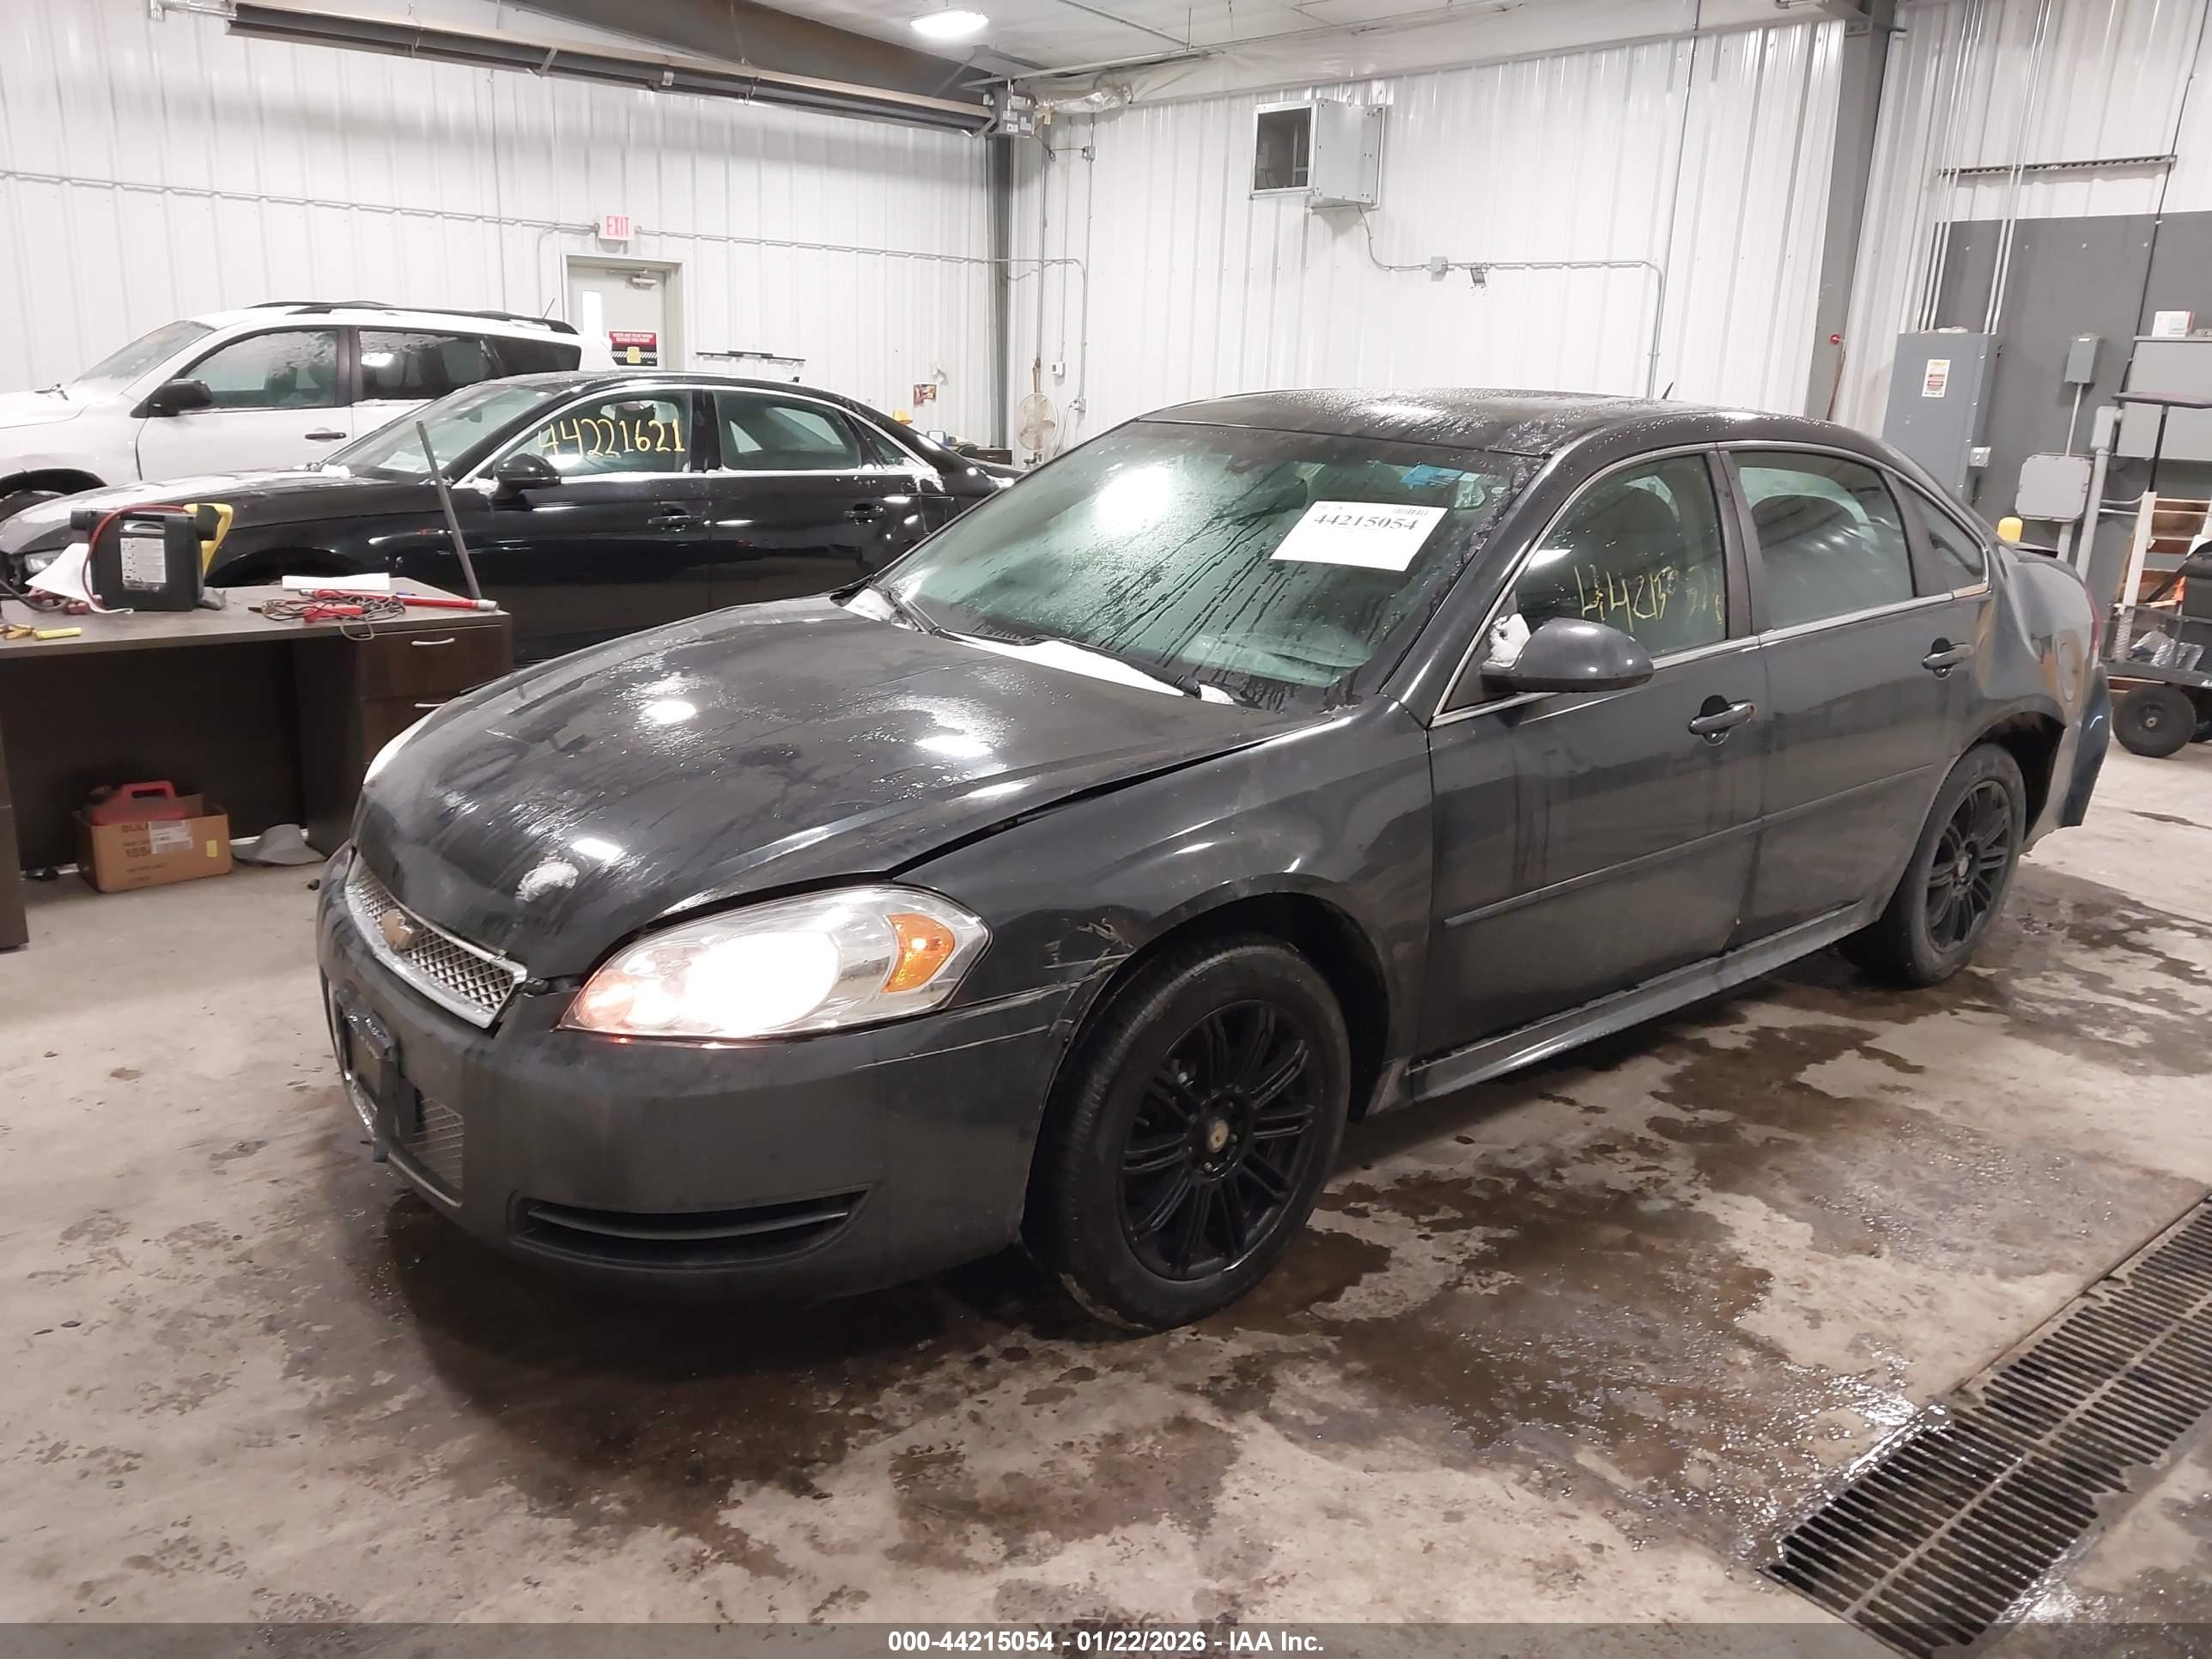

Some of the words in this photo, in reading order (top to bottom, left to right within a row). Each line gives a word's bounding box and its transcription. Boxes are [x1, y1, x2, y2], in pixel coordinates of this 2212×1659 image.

[606, 215, 629, 237] EXIT
[538, 417, 685, 459] 44221621
[1314, 514, 1419, 531] 44215054
